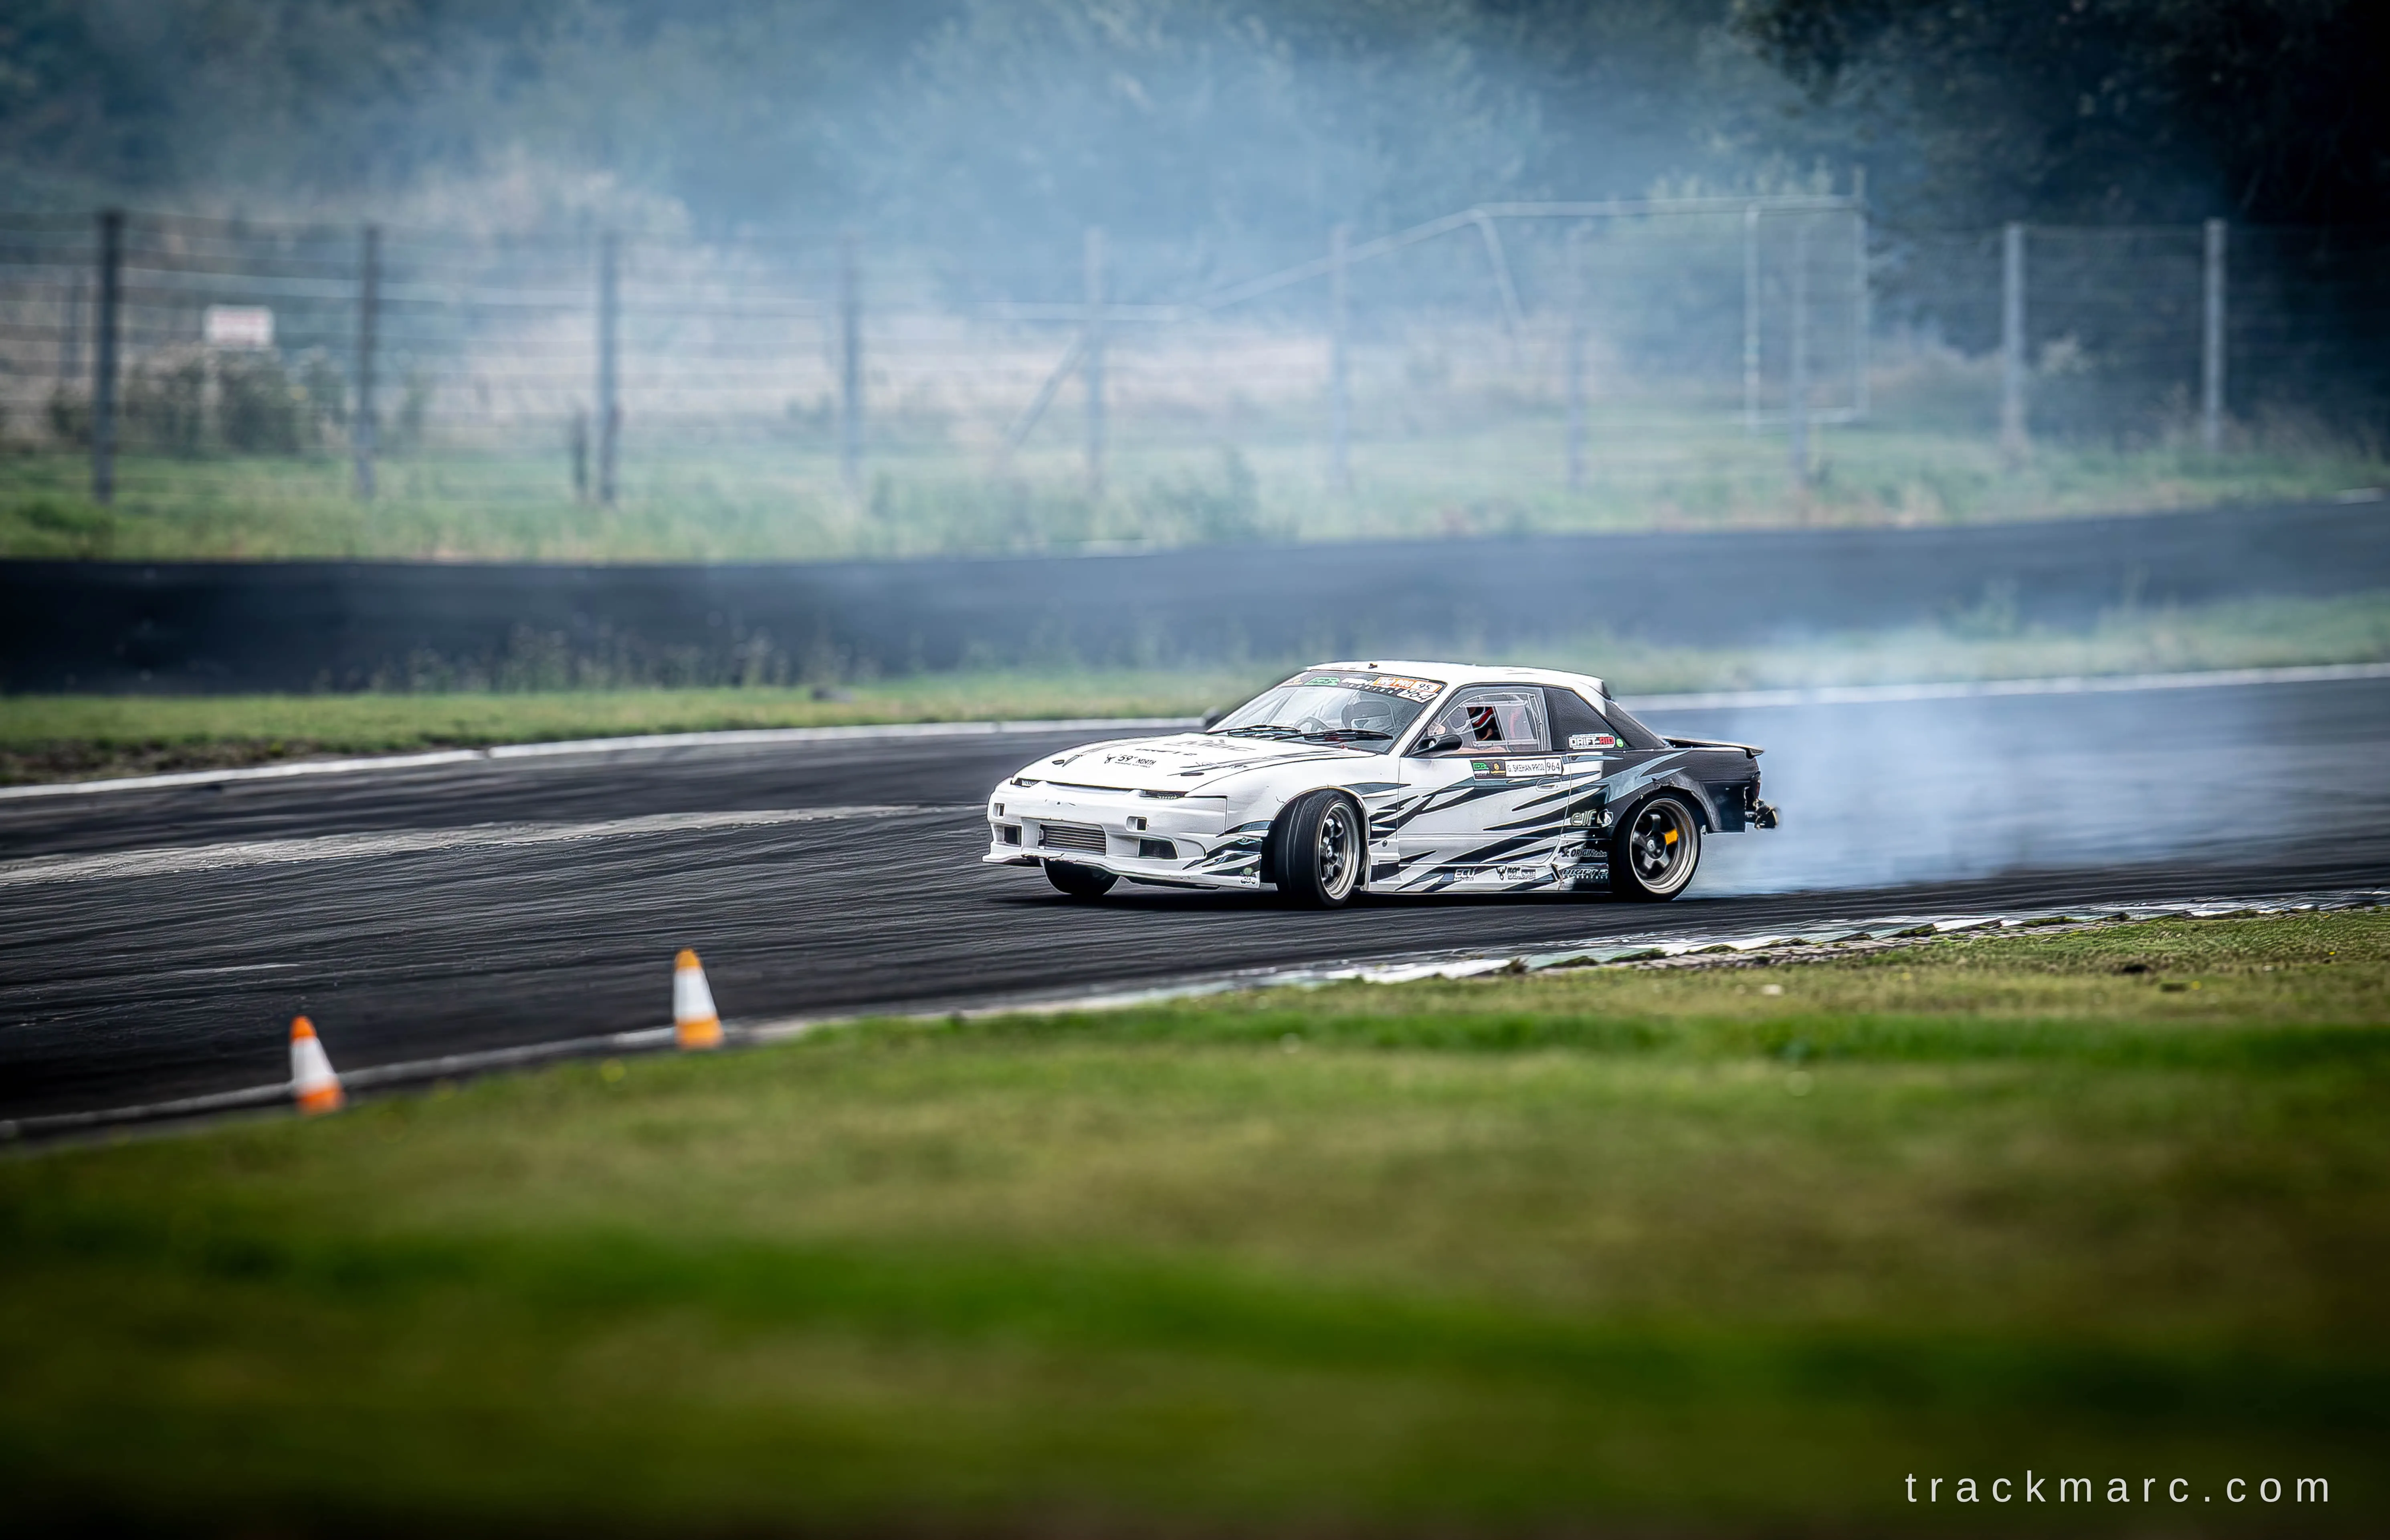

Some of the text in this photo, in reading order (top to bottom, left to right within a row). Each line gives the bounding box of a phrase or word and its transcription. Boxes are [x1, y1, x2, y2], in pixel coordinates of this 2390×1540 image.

[1546, 762, 1560, 771] 964
[1570, 808, 1597, 826] elf
[1454, 867, 1477, 877] ECU
